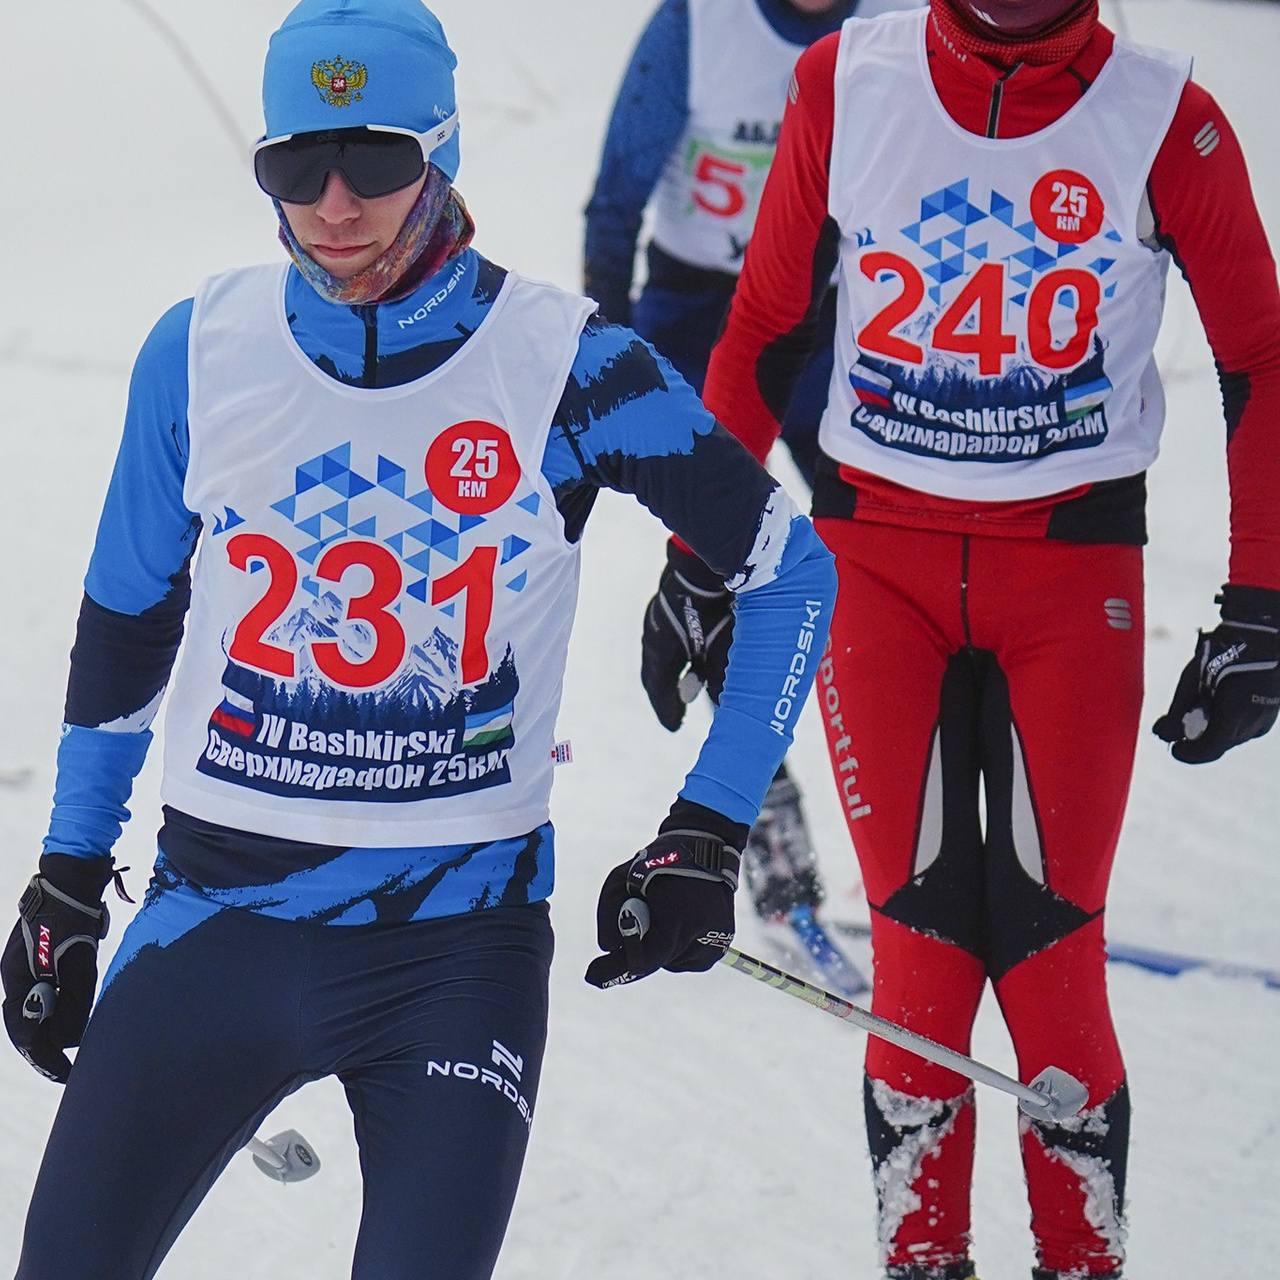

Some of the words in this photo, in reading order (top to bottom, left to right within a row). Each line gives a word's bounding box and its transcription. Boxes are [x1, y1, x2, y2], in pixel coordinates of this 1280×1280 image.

[1049, 181, 1089, 219] 25
[398, 263, 466, 329] NORDSKI
[857, 251, 1101, 376] 240
[449, 438, 499, 479] 25
[227, 533, 498, 688] 231
[256, 713, 287, 749] IV
